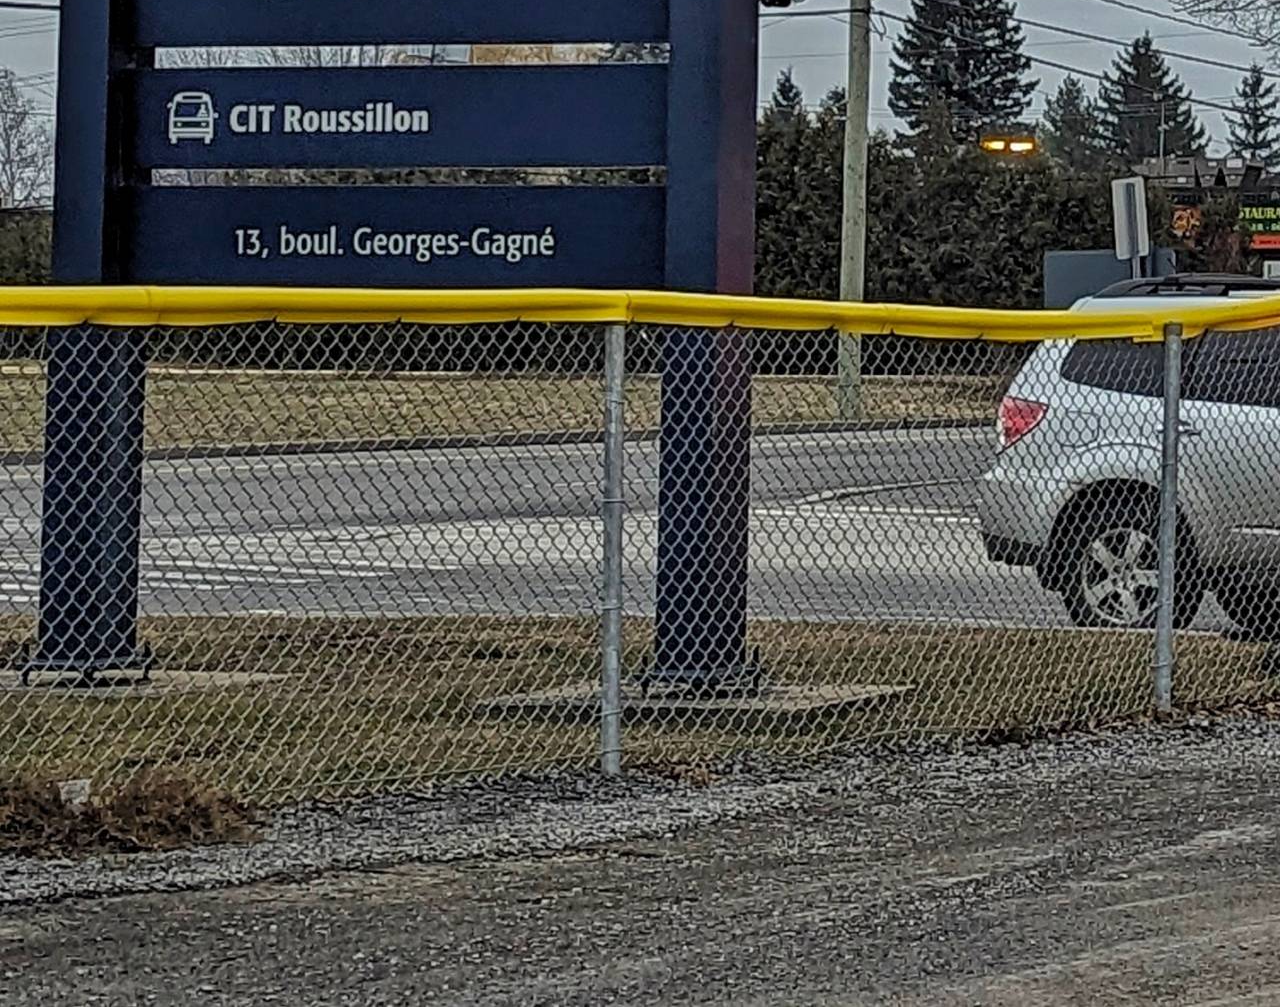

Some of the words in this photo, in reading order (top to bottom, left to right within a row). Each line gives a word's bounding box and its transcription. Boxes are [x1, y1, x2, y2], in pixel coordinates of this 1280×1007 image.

[229, 104, 276, 133] CIT
[283, 101, 430, 134] Roussillon
[235, 228, 269, 259] 13,
[279, 225, 344, 256] boul.
[353, 226, 556, 263] Georges-Gagné
